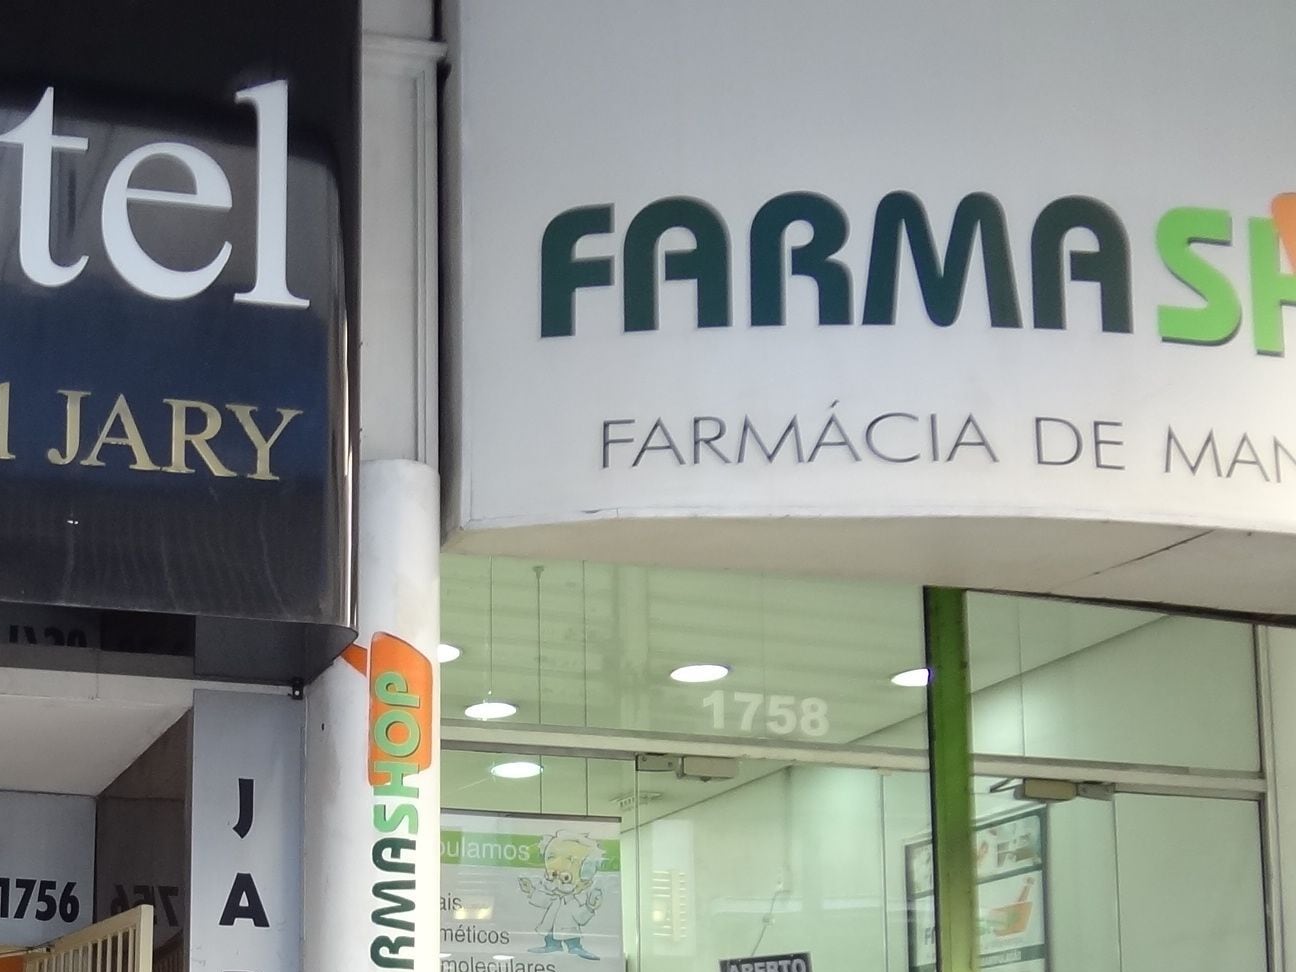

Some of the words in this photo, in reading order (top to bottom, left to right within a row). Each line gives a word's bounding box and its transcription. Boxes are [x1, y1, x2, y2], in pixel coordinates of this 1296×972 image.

[46, 390, 304, 482] JARY
[600, 400, 999, 470] FARMÁCIA
[1035, 416, 1127, 471] DE
[702, 689, 831, 737] 1758
